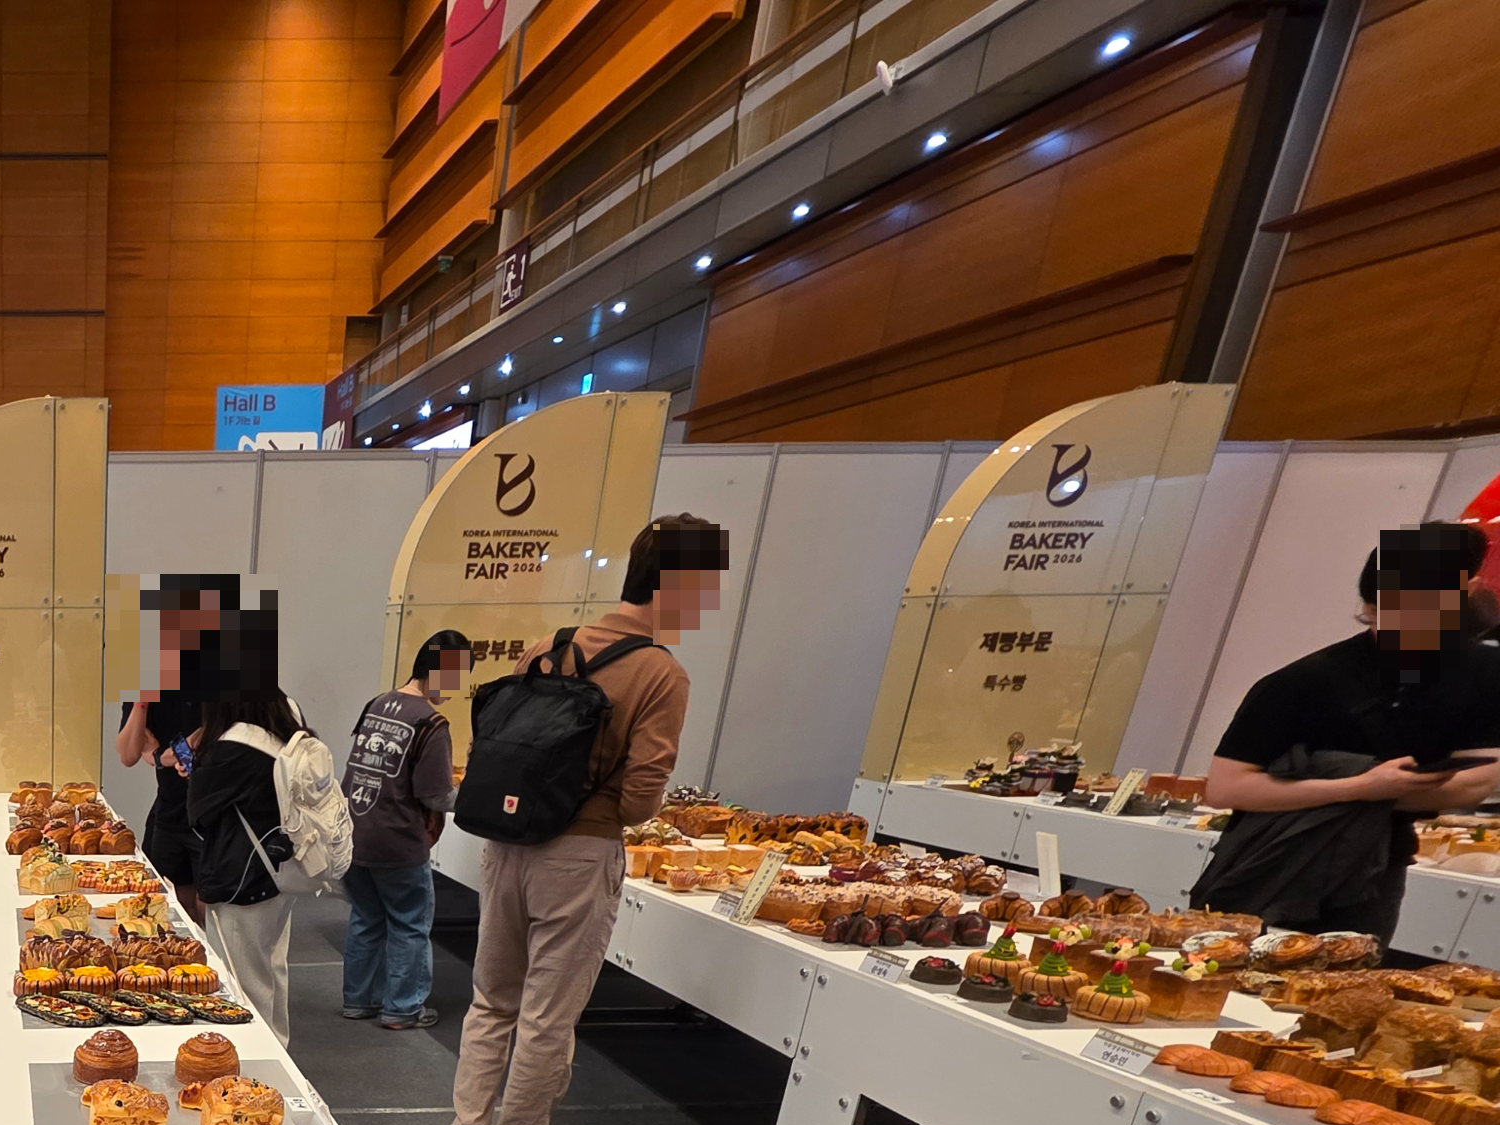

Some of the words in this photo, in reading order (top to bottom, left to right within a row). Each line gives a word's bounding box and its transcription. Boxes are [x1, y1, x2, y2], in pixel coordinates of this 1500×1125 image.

[224, 394, 258, 412] Hall
[263, 395, 276, 412] B
[223, 416, 234, 426] 1F
[492, 529, 559, 537] INTERNATIONAL
[1038, 520, 1104, 528] INTERNATIONAL
[467, 541, 550, 559] BAKERY
[1009, 532, 1094, 550] BAKERY
[1003, 554, 1049, 571] FAIR
[1052, 553, 1082, 563] 2026
[465, 563, 509, 580] FAIR
[512, 563, 542, 572] 2026
[470, 639, 525, 661] 빵부문
[979, 631, 1053, 653] 제빵부문
[352, 786, 372, 806] 44
